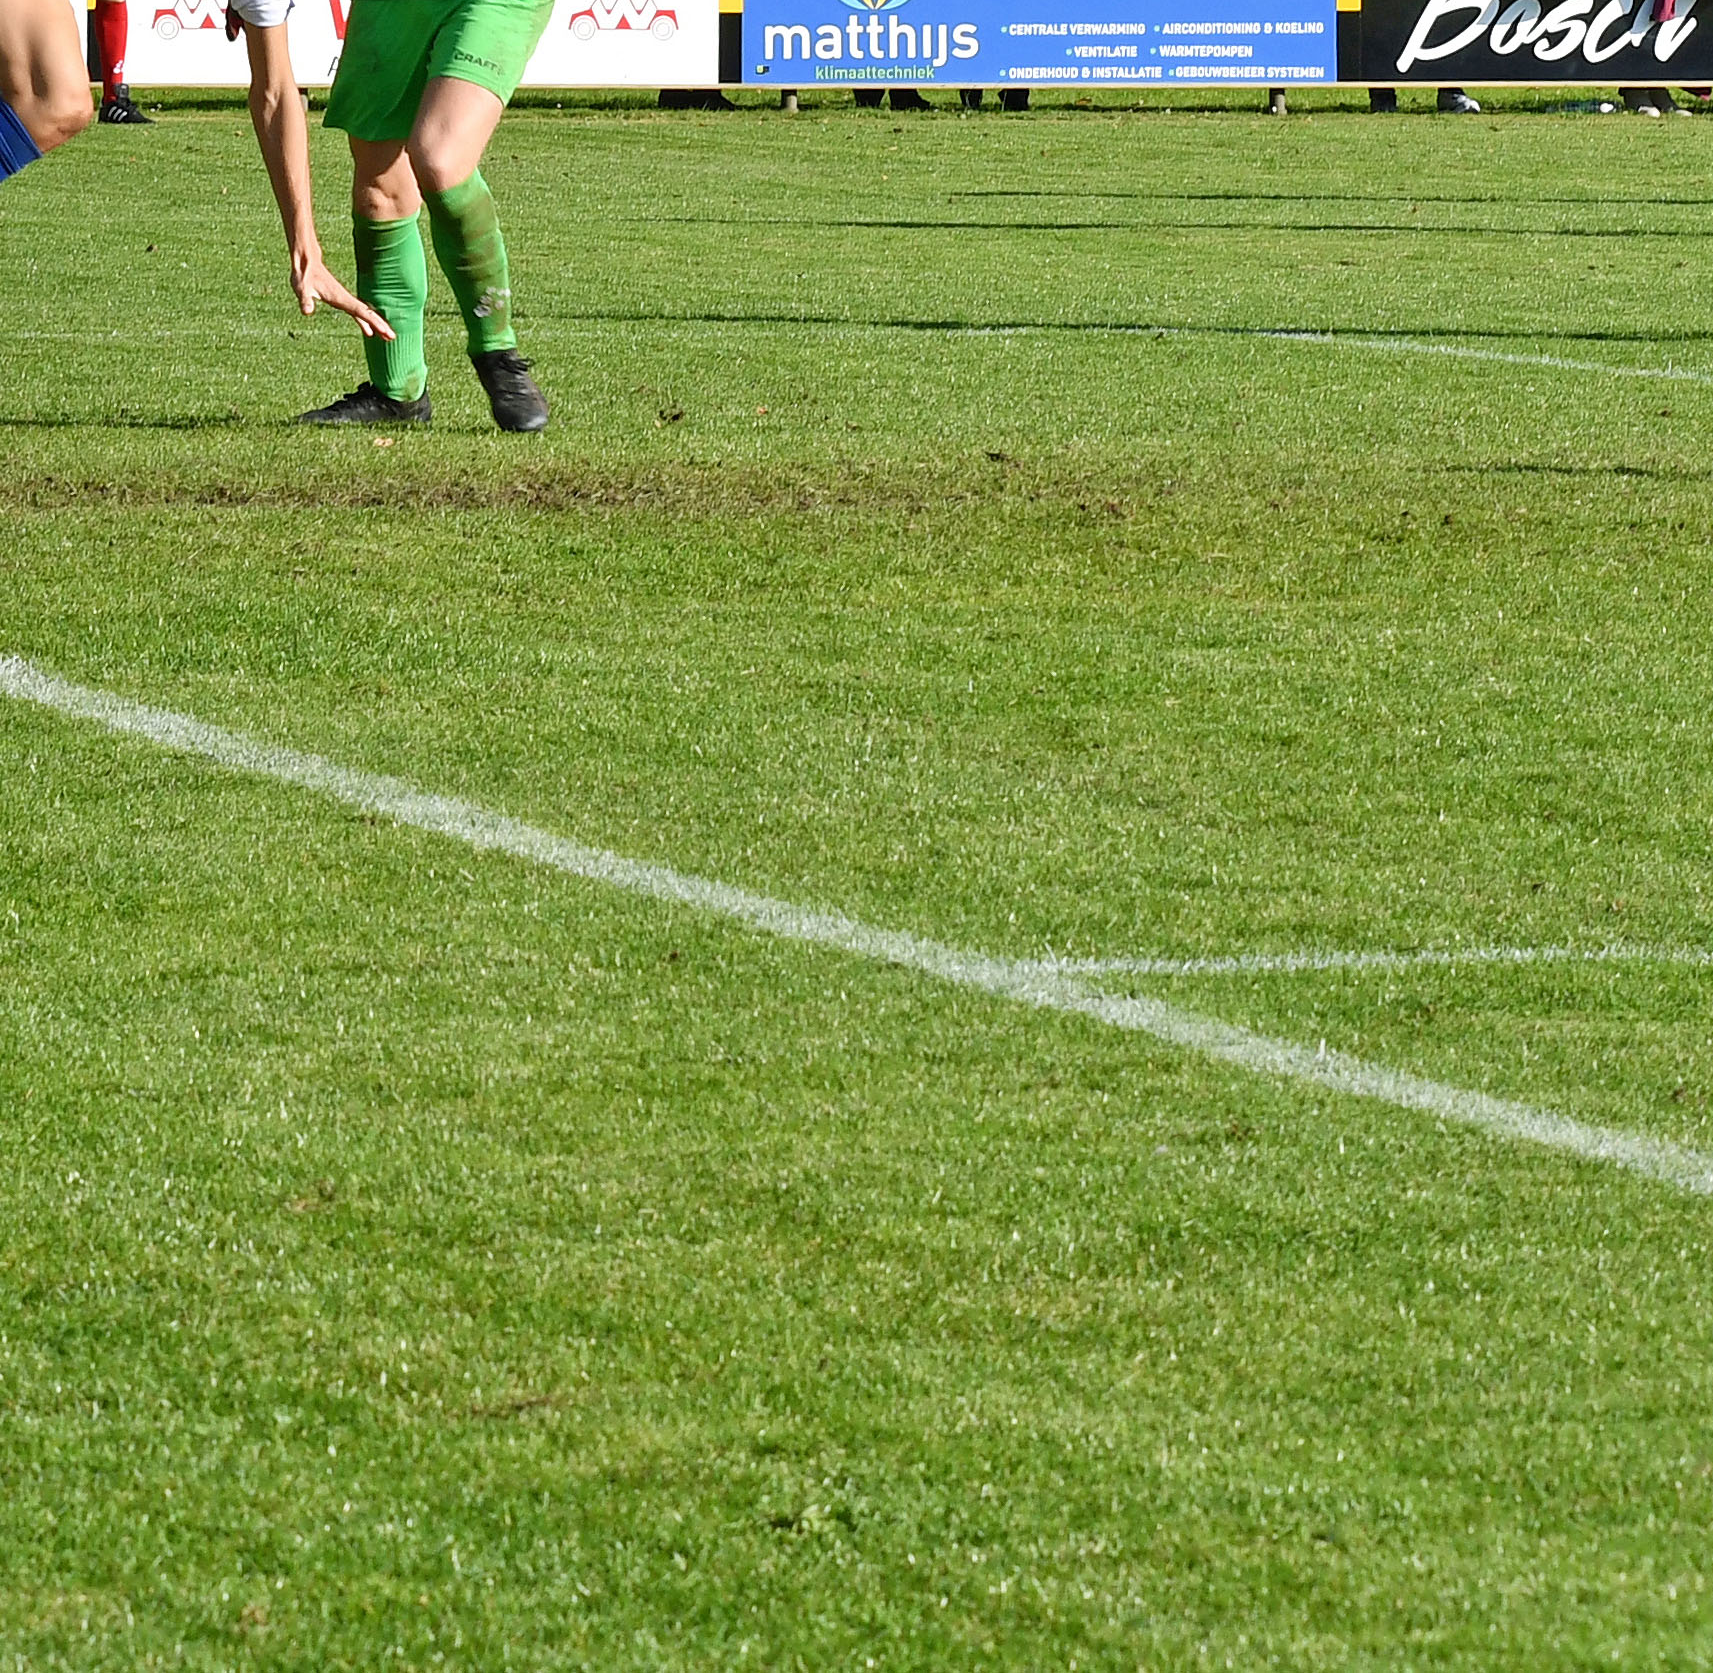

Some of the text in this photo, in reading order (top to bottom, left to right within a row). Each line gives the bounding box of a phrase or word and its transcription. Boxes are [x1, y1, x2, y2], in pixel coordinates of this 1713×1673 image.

[1009, 23, 1068, 35] CENTRALE
[1069, 23, 1146, 35] VERWARMING
[1162, 22, 1261, 35] AIRCONDITIONING
[1275, 22, 1324, 34] KOELING
[764, 15, 979, 67] matthijs
[1074, 45, 1253, 58] VENTILATIE WARMTEPOMPEN
[815, 65, 935, 80] klimaattechniek
[1009, 67, 1078, 79] ONDERHOUD
[1092, 67, 1162, 78] INSTALLATIE
[1176, 67, 1266, 79] GEBOUWBEHEER
[1267, 67, 1324, 79] SYSTEMEN
